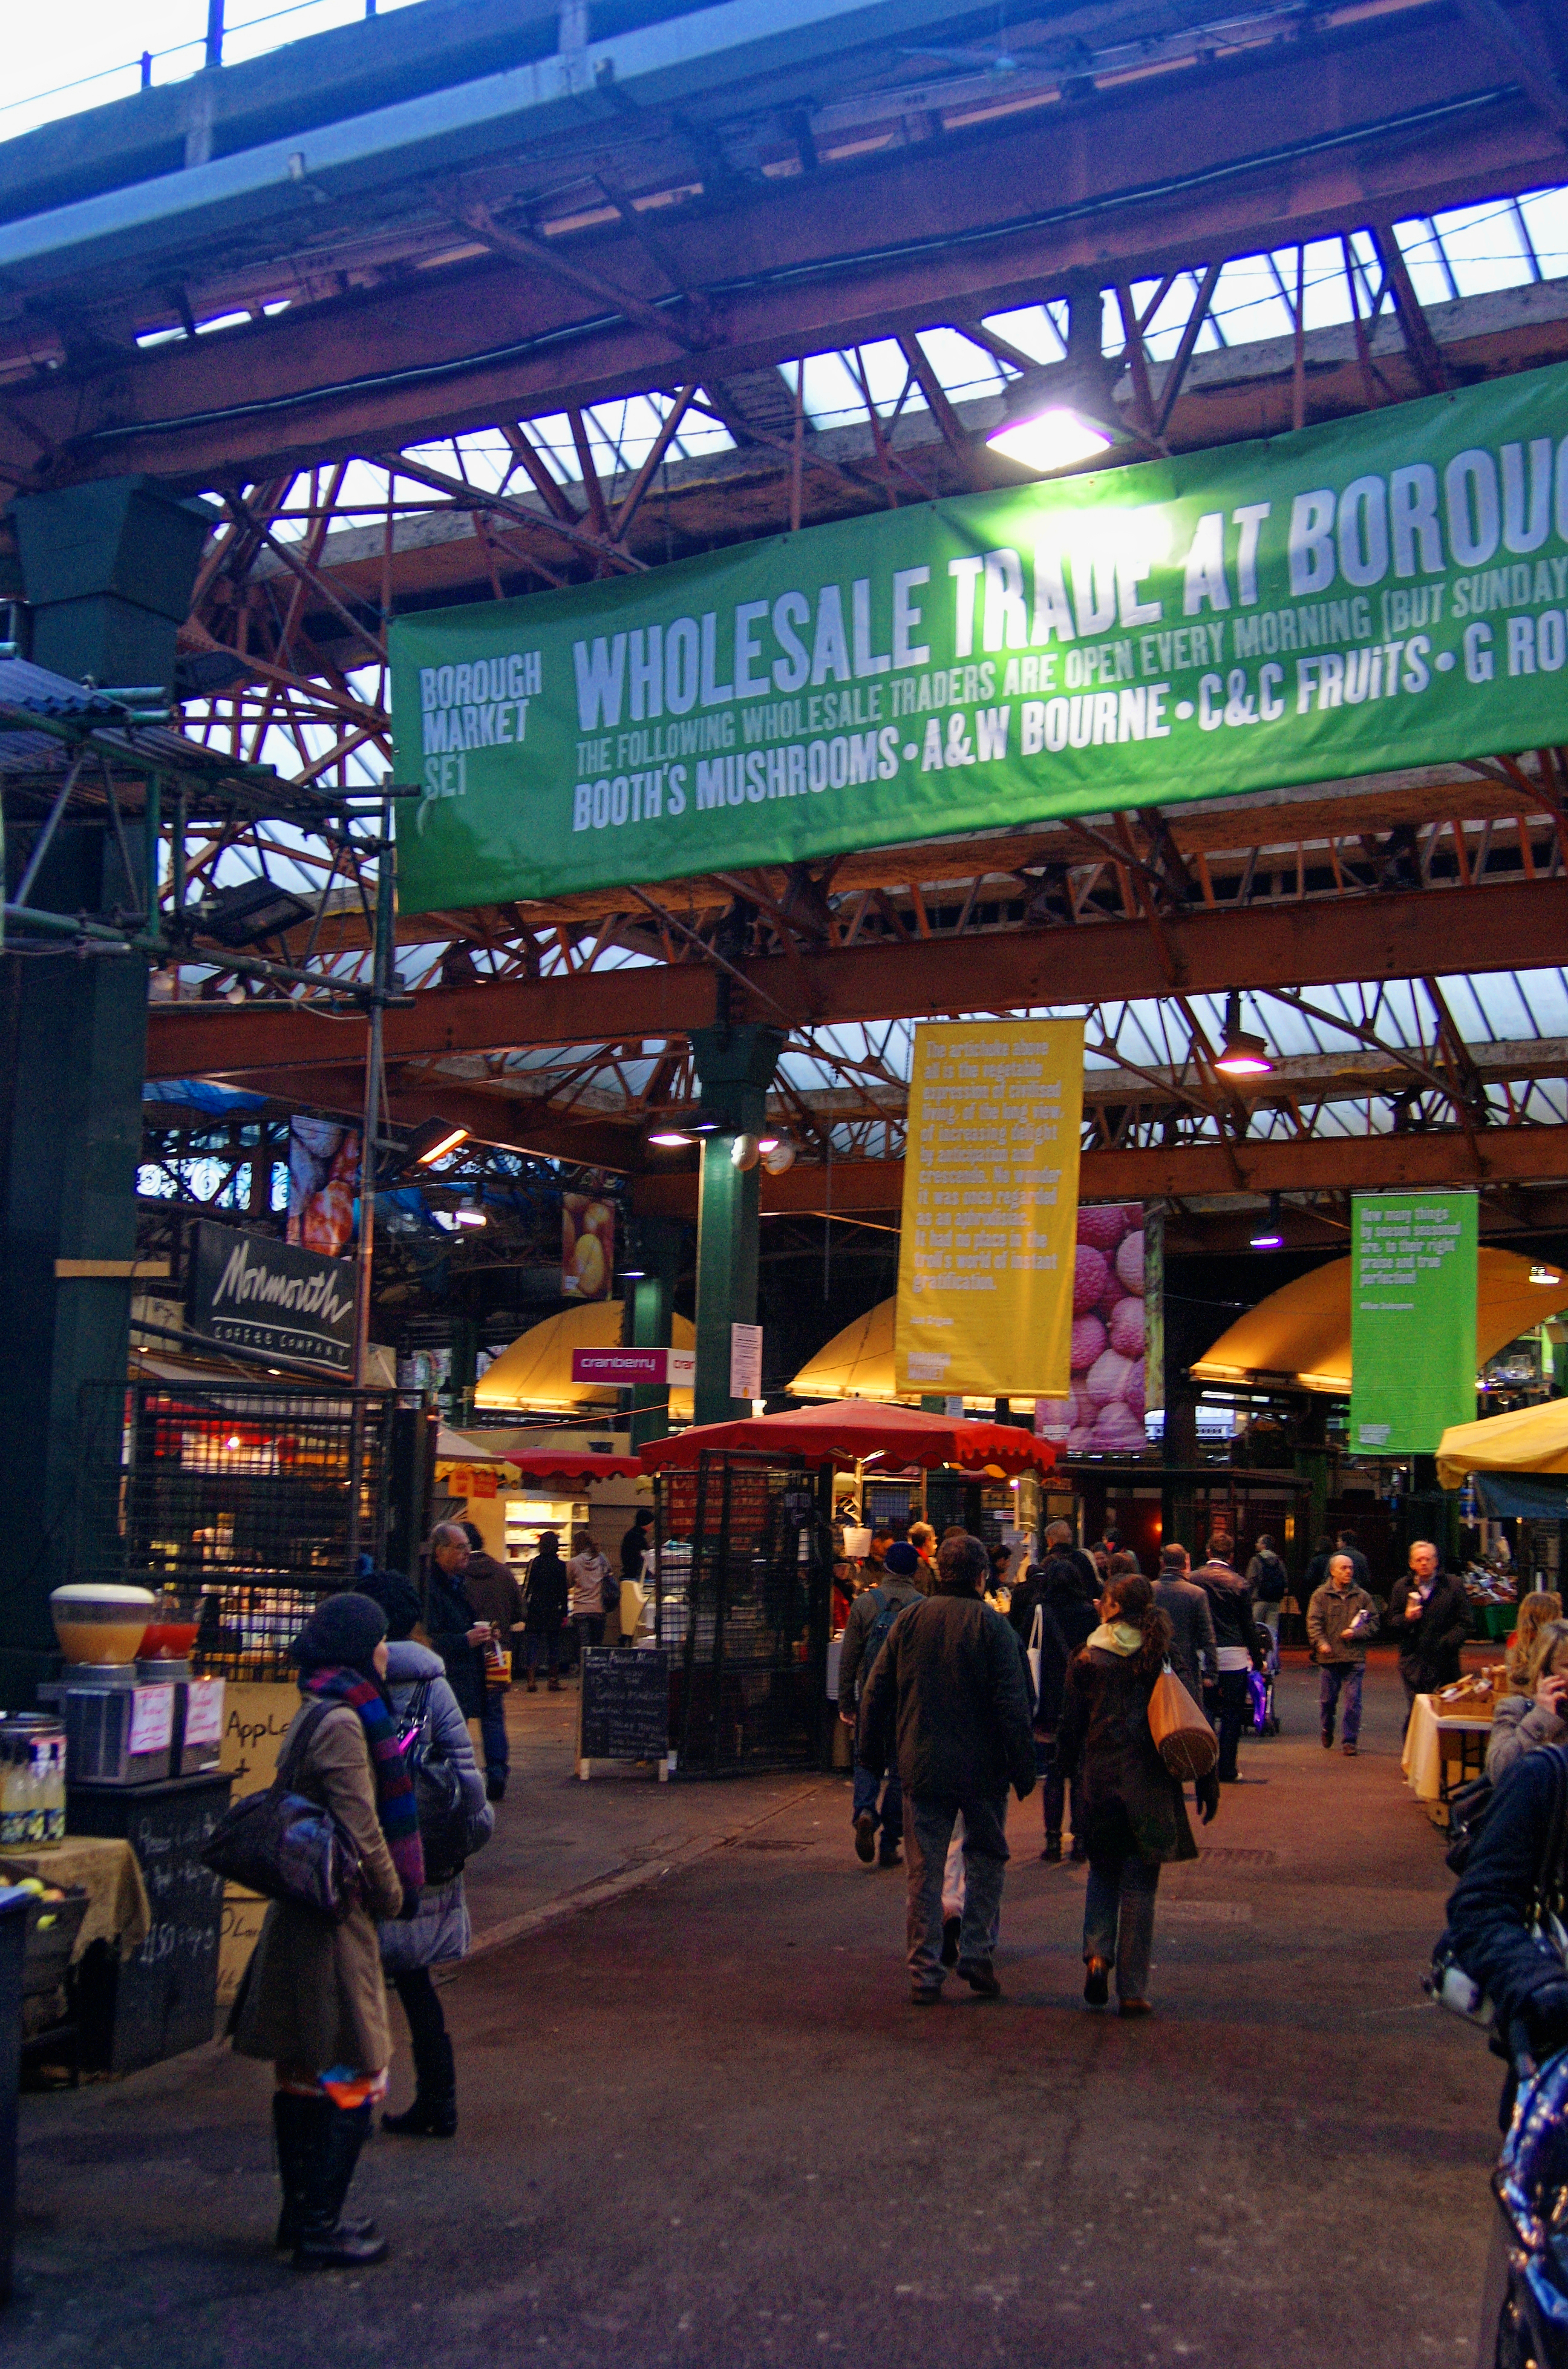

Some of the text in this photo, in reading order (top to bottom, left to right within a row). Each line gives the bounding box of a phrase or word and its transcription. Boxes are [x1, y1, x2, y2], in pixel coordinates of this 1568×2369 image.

[572, 567, 929, 730] WHOLESALE
[949, 514, 1162, 657] TRADE
[1184, 503, 1270, 616] AT
[420, 650, 542, 712] BOROUGH
[577, 736, 613, 776] THE
[617, 711, 736, 769] FOLLOWING
[742, 684, 883, 744] WHOLESALE
[890, 661, 996, 718] TRADERS
[1002, 653, 1058, 697] ARE
[1065, 638, 1135, 689] OPEN
[1140, 621, 1225, 675] EVERY
[1233, 595, 1373, 660] MORNING
[1380, 583, 1446, 641] (BUT
[423, 698, 530, 755] MARKET
[572, 762, 688, 832] BOOTH'S
[1507, 608, 1568, 677] RO
[425, 754, 465, 800] SE1
[212, 1240, 353, 1323] Monmouth
[580, 1357, 656, 1372] cranberry
